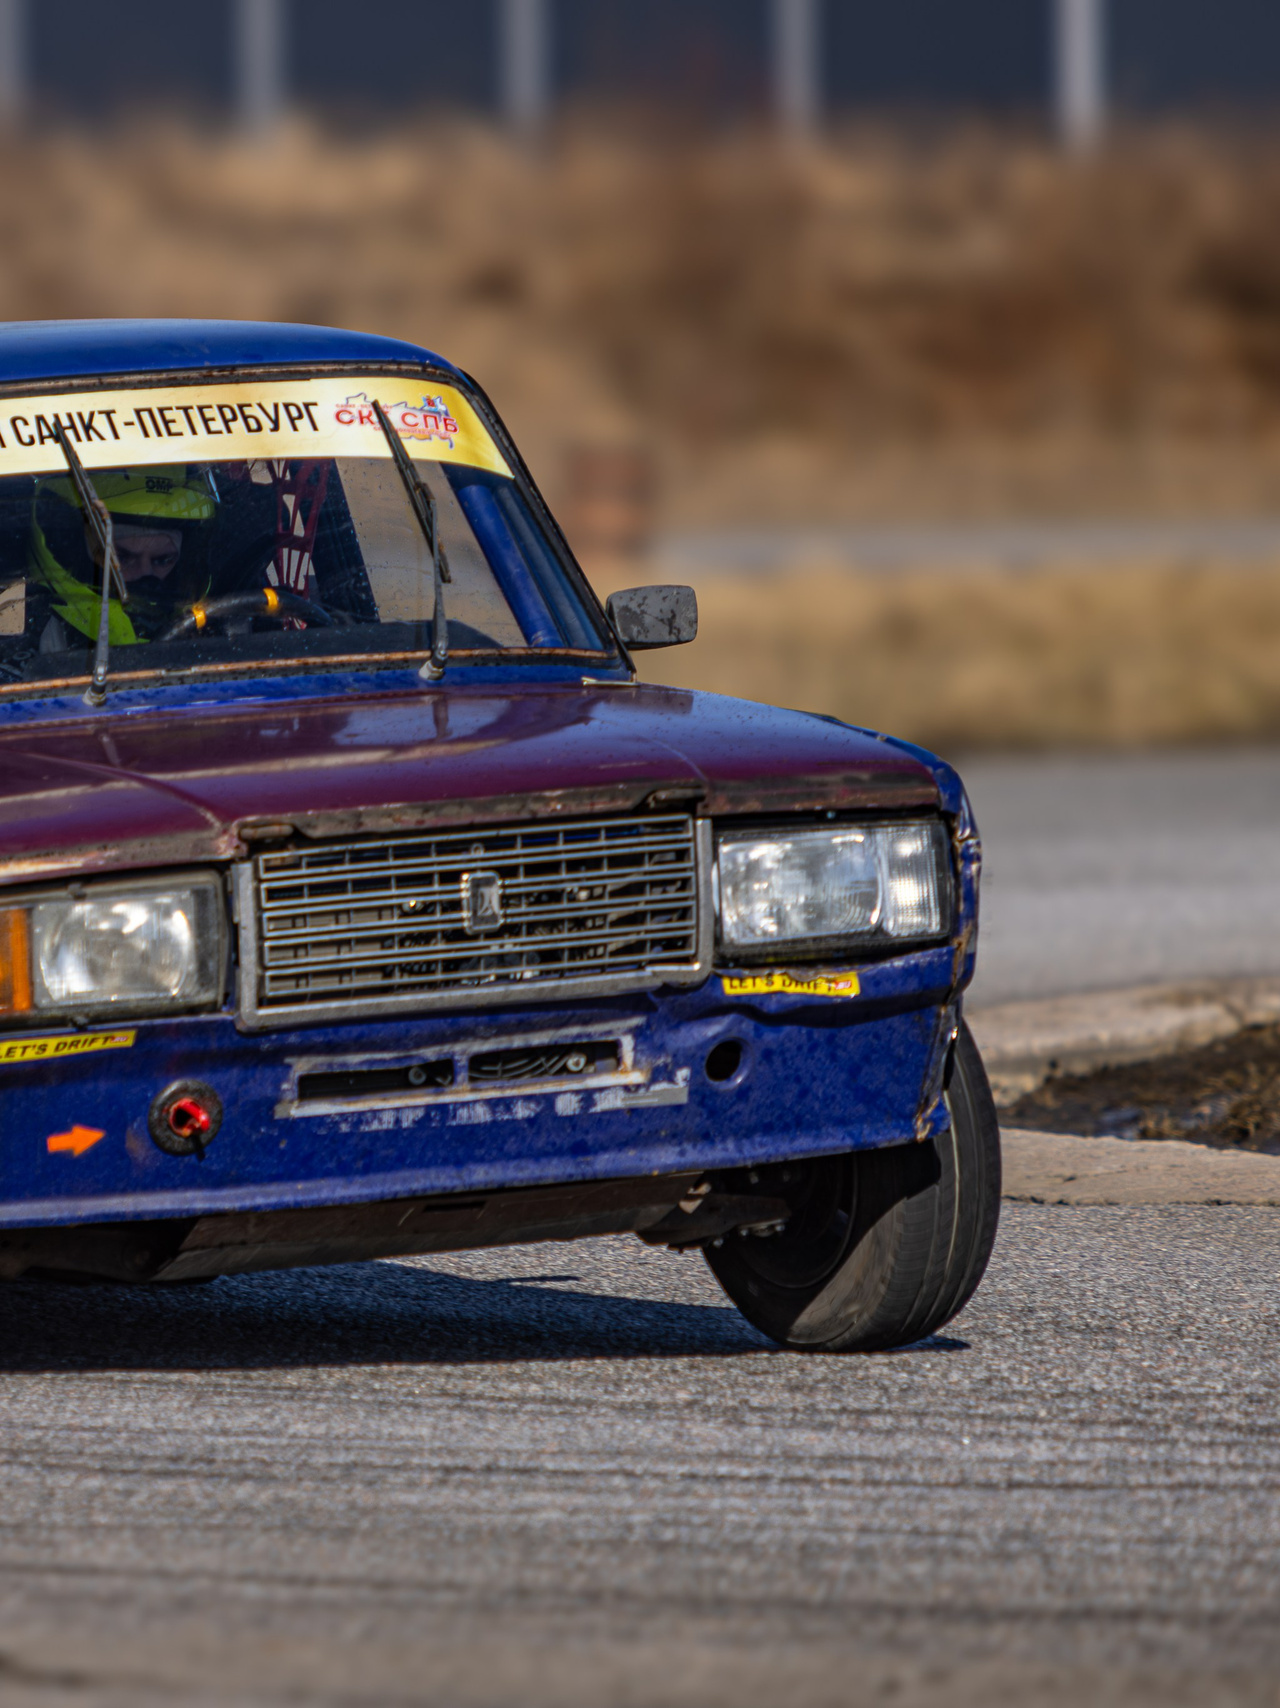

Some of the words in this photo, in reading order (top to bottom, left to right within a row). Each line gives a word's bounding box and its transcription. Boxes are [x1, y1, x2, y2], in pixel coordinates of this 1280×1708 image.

[10, 401, 319, 447] САНКТ-ПЕТЕРБУРГ
[335, 409, 389, 426] СК
[401, 412, 459, 433] СПБ
[729, 972, 775, 990] LETS
